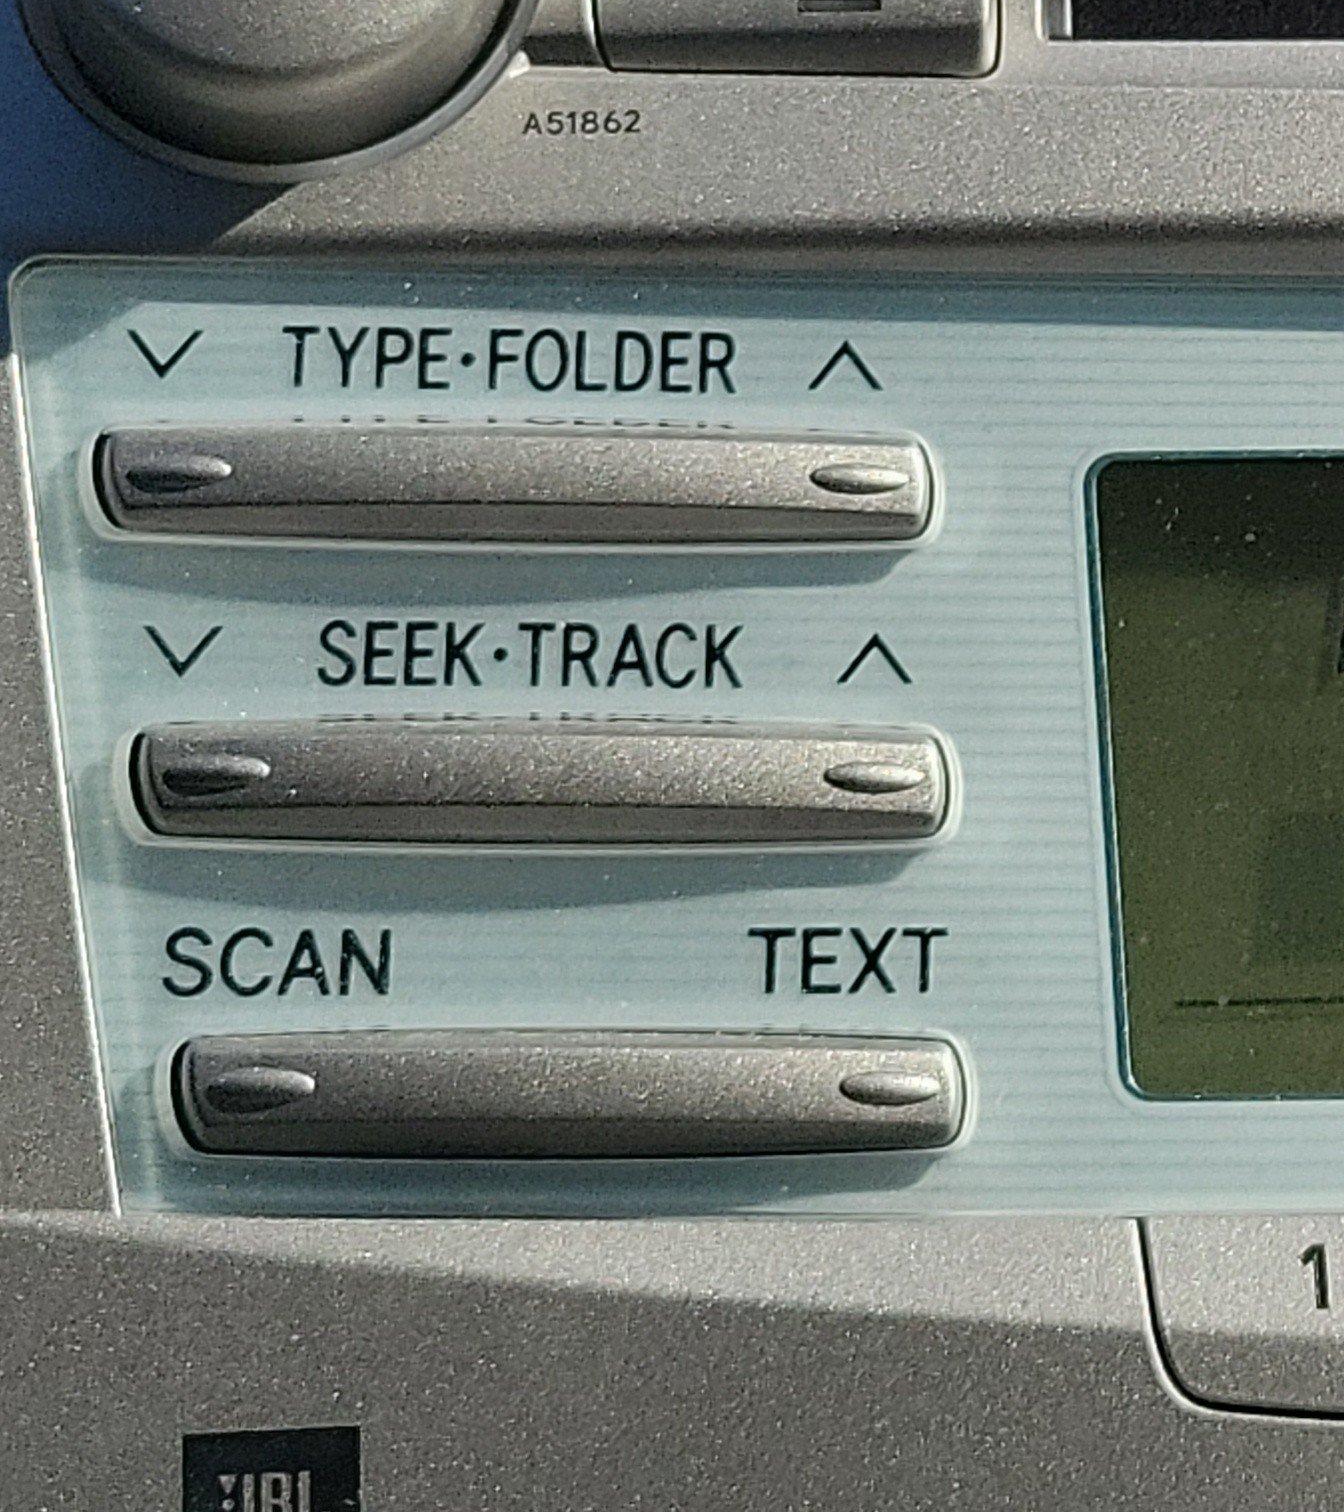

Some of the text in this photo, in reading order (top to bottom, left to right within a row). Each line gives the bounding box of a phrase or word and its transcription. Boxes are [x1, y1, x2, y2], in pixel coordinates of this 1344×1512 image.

[522, 110, 641, 135] A51862
[162, 928, 392, 997] SCAN
[747, 926, 950, 994] TEXT
[1297, 1244, 1330, 1311] 1
